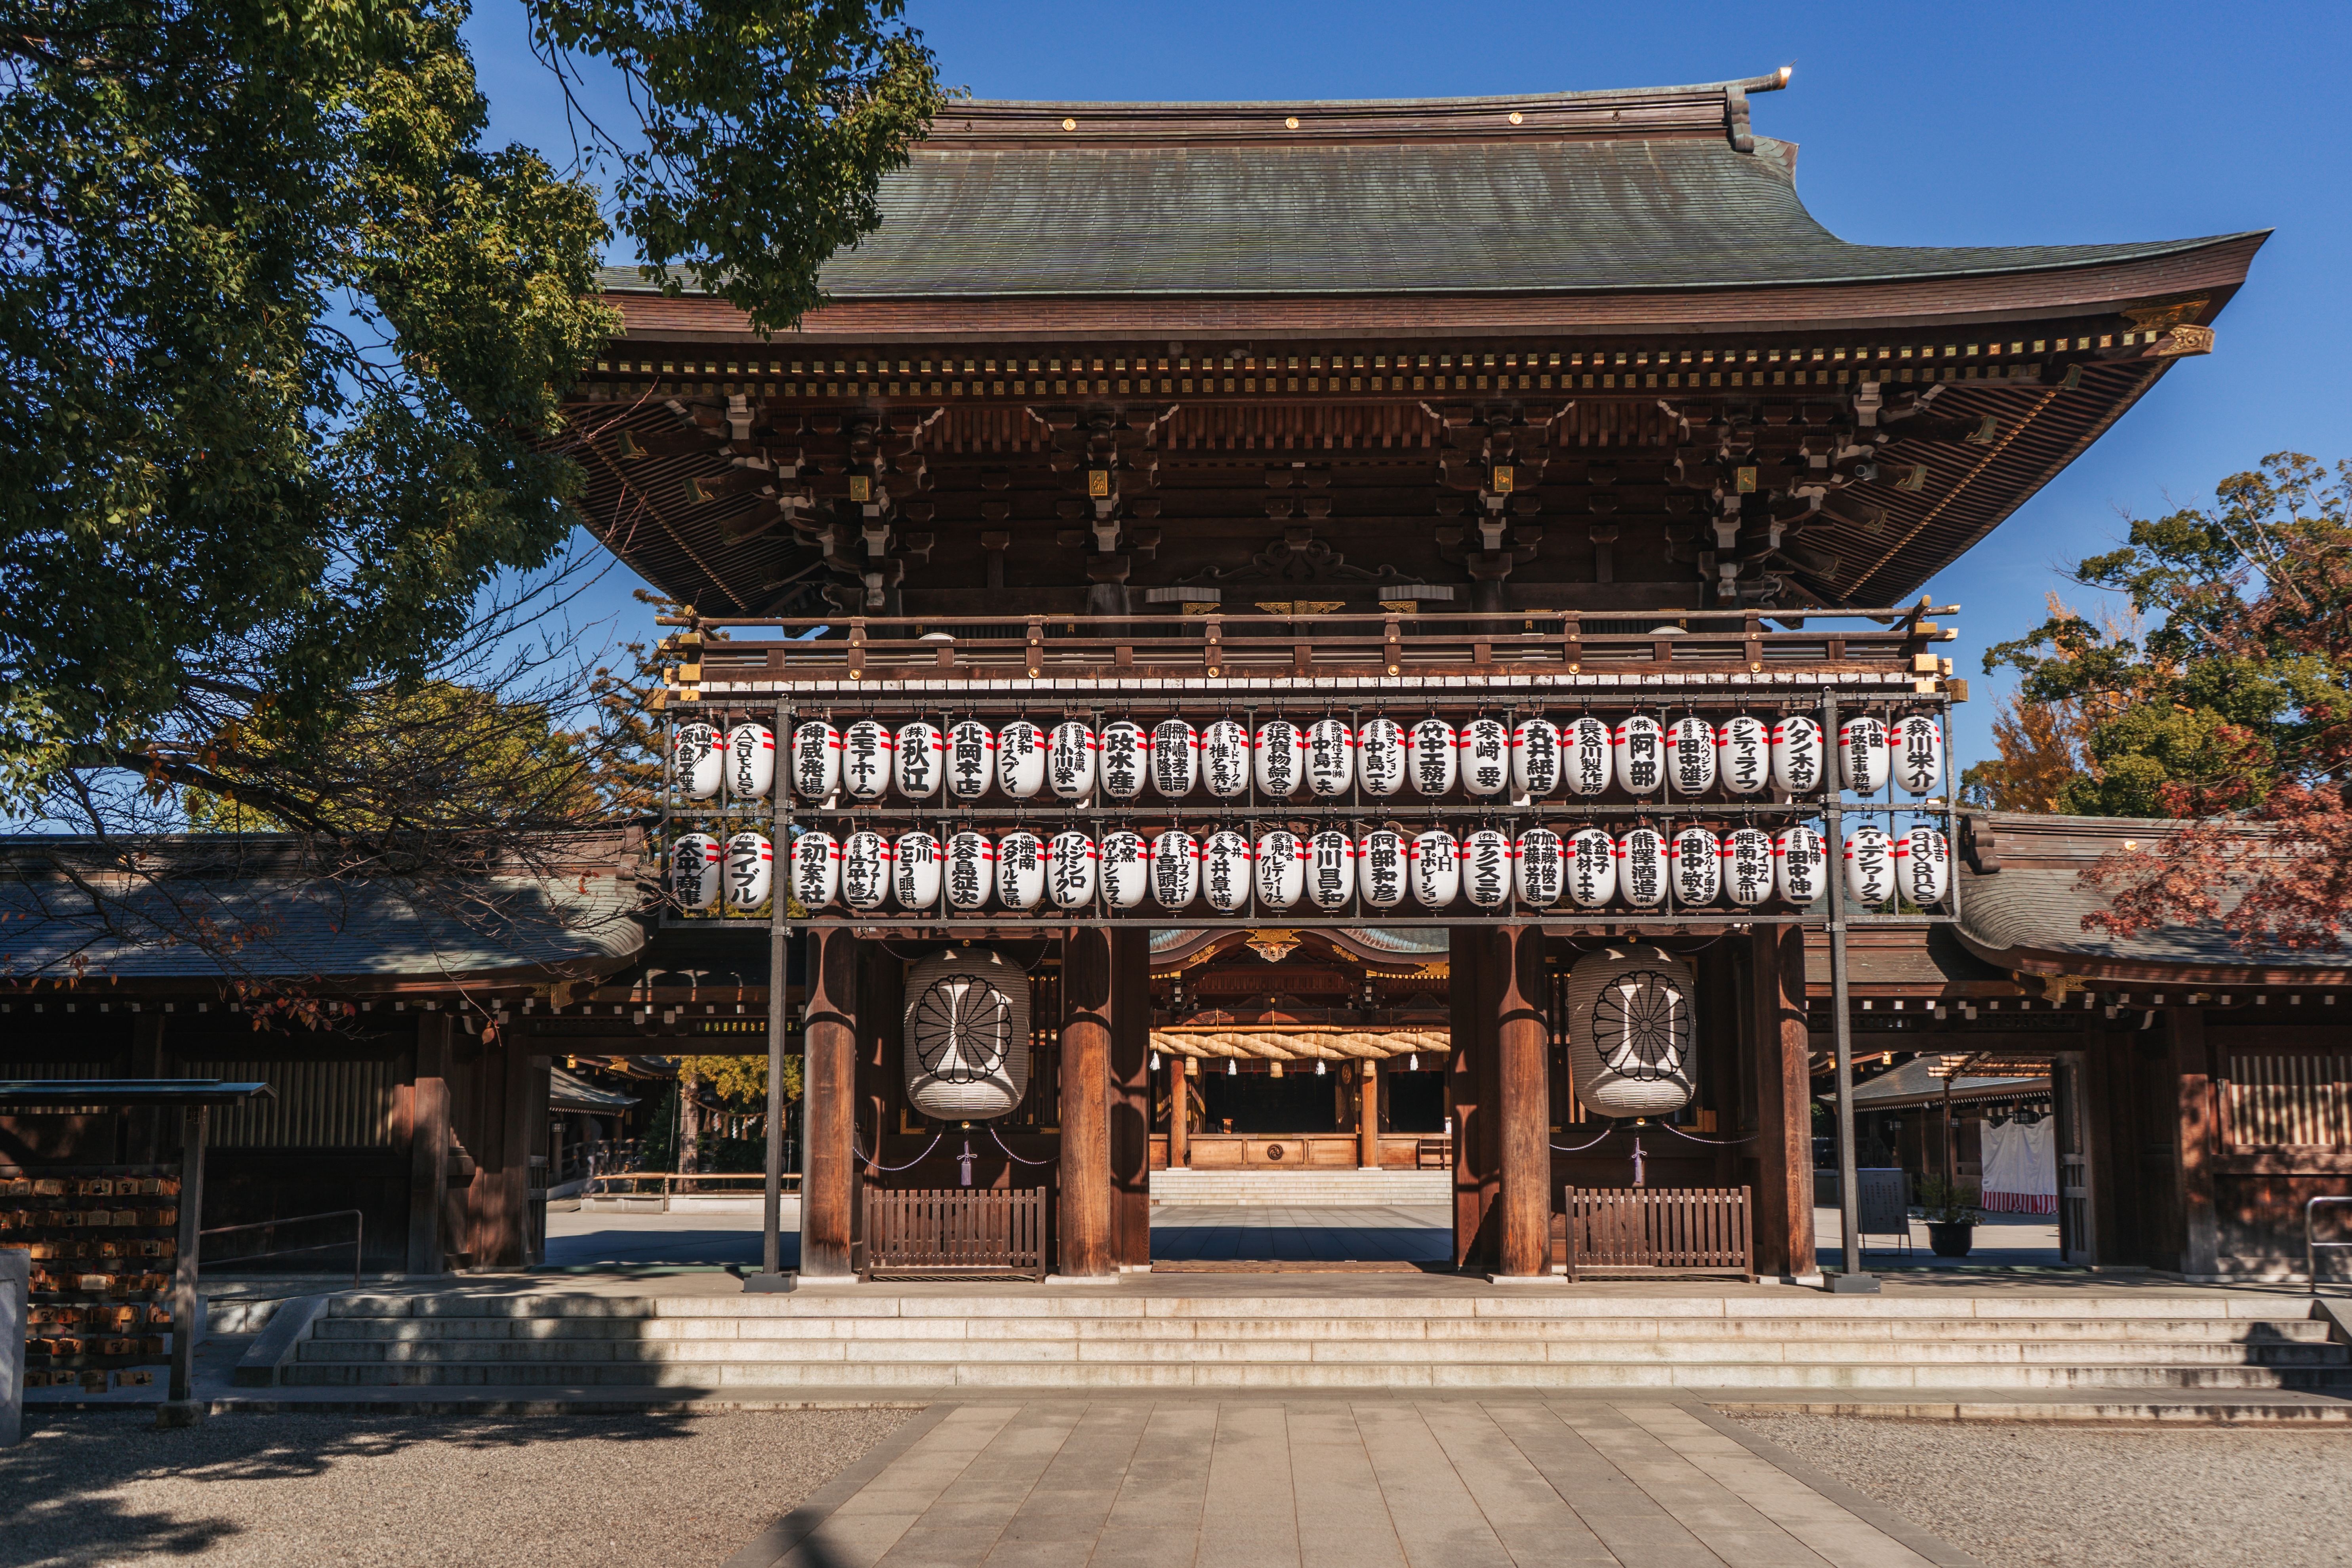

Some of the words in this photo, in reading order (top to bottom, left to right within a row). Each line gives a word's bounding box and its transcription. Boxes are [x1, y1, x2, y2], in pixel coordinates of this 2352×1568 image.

[679, 728, 696, 793] 板金工業
[734, 725, 758, 795] (株)Asutrust
[850, 723, 876, 794] (株)エモアホーム
[902, 726, 930, 792] (株)秋江
[955, 723, 982, 794] (株)北岡本店
[1002, 726, 1019, 793] ディスプレイ
[1017, 724, 1033, 755] (株)晃和
[1107, 724, 1135, 794] 一政水産(株)
[1156, 723, 1172, 791] 間野隆司
[1418, 721, 1447, 793] (株)竹中工務店
[1527, 721, 1554, 791] (株)丸井紙店
[1578, 720, 1603, 793] (株)長谷川製作所
[1630, 720, 1656, 787] (株)阿部
[1733, 719, 1758, 789] (株)シティライフ
[1787, 719, 1815, 789] ハタノ木材(株)
[1850, 724, 1870, 791] 行政書士事務所
[1868, 720, 1883, 748] 小田
[1906, 719, 1934, 787] 森川栄介
[676, 835, 703, 906] (株)太平商事
[731, 835, 760, 903] (株)エイブル
[800, 835, 827, 904] (株)初案社
[864, 833, 880, 901] (株)サイファーム
[900, 836, 917, 904] ごとう眼科
[915, 835, 932, 864] 寒川
[1003, 840, 1021, 905] スタイル工房
[1019, 835, 1036, 871] (株)湘南
[1053, 837, 1076, 904] リサイクル
[1069, 835, 1086, 888] フジシロ
[1104, 838, 1124, 905] ガーデンテラス
[1119, 834, 1137, 862] 石窯
[1174, 833, 1190, 901] (株)タカトープランナー
[1227, 833, 1242, 858] (有)今井
[1261, 855, 1273, 903] クリニック
[1271, 834, 1286, 903] 愛児レディース
[1315, 833, 1345, 905] 柏川昌和
[1371, 834, 1398, 901] 阿部和彦
[1420, 839, 1438, 904] コーポレーション
[1437, 835, 1453, 871] (株)TH
[1475, 833, 1501, 903] (株)テクノス三和
[1524, 832, 1541, 902] 加藤芳恵
[1576, 838, 1596, 902] 建材土木
[1591, 832, 1610, 874] (株)金子
[1631, 832, 1657, 903] 熊澤酒造(株)
[1858, 831, 1886, 902] ガーデンワークス
